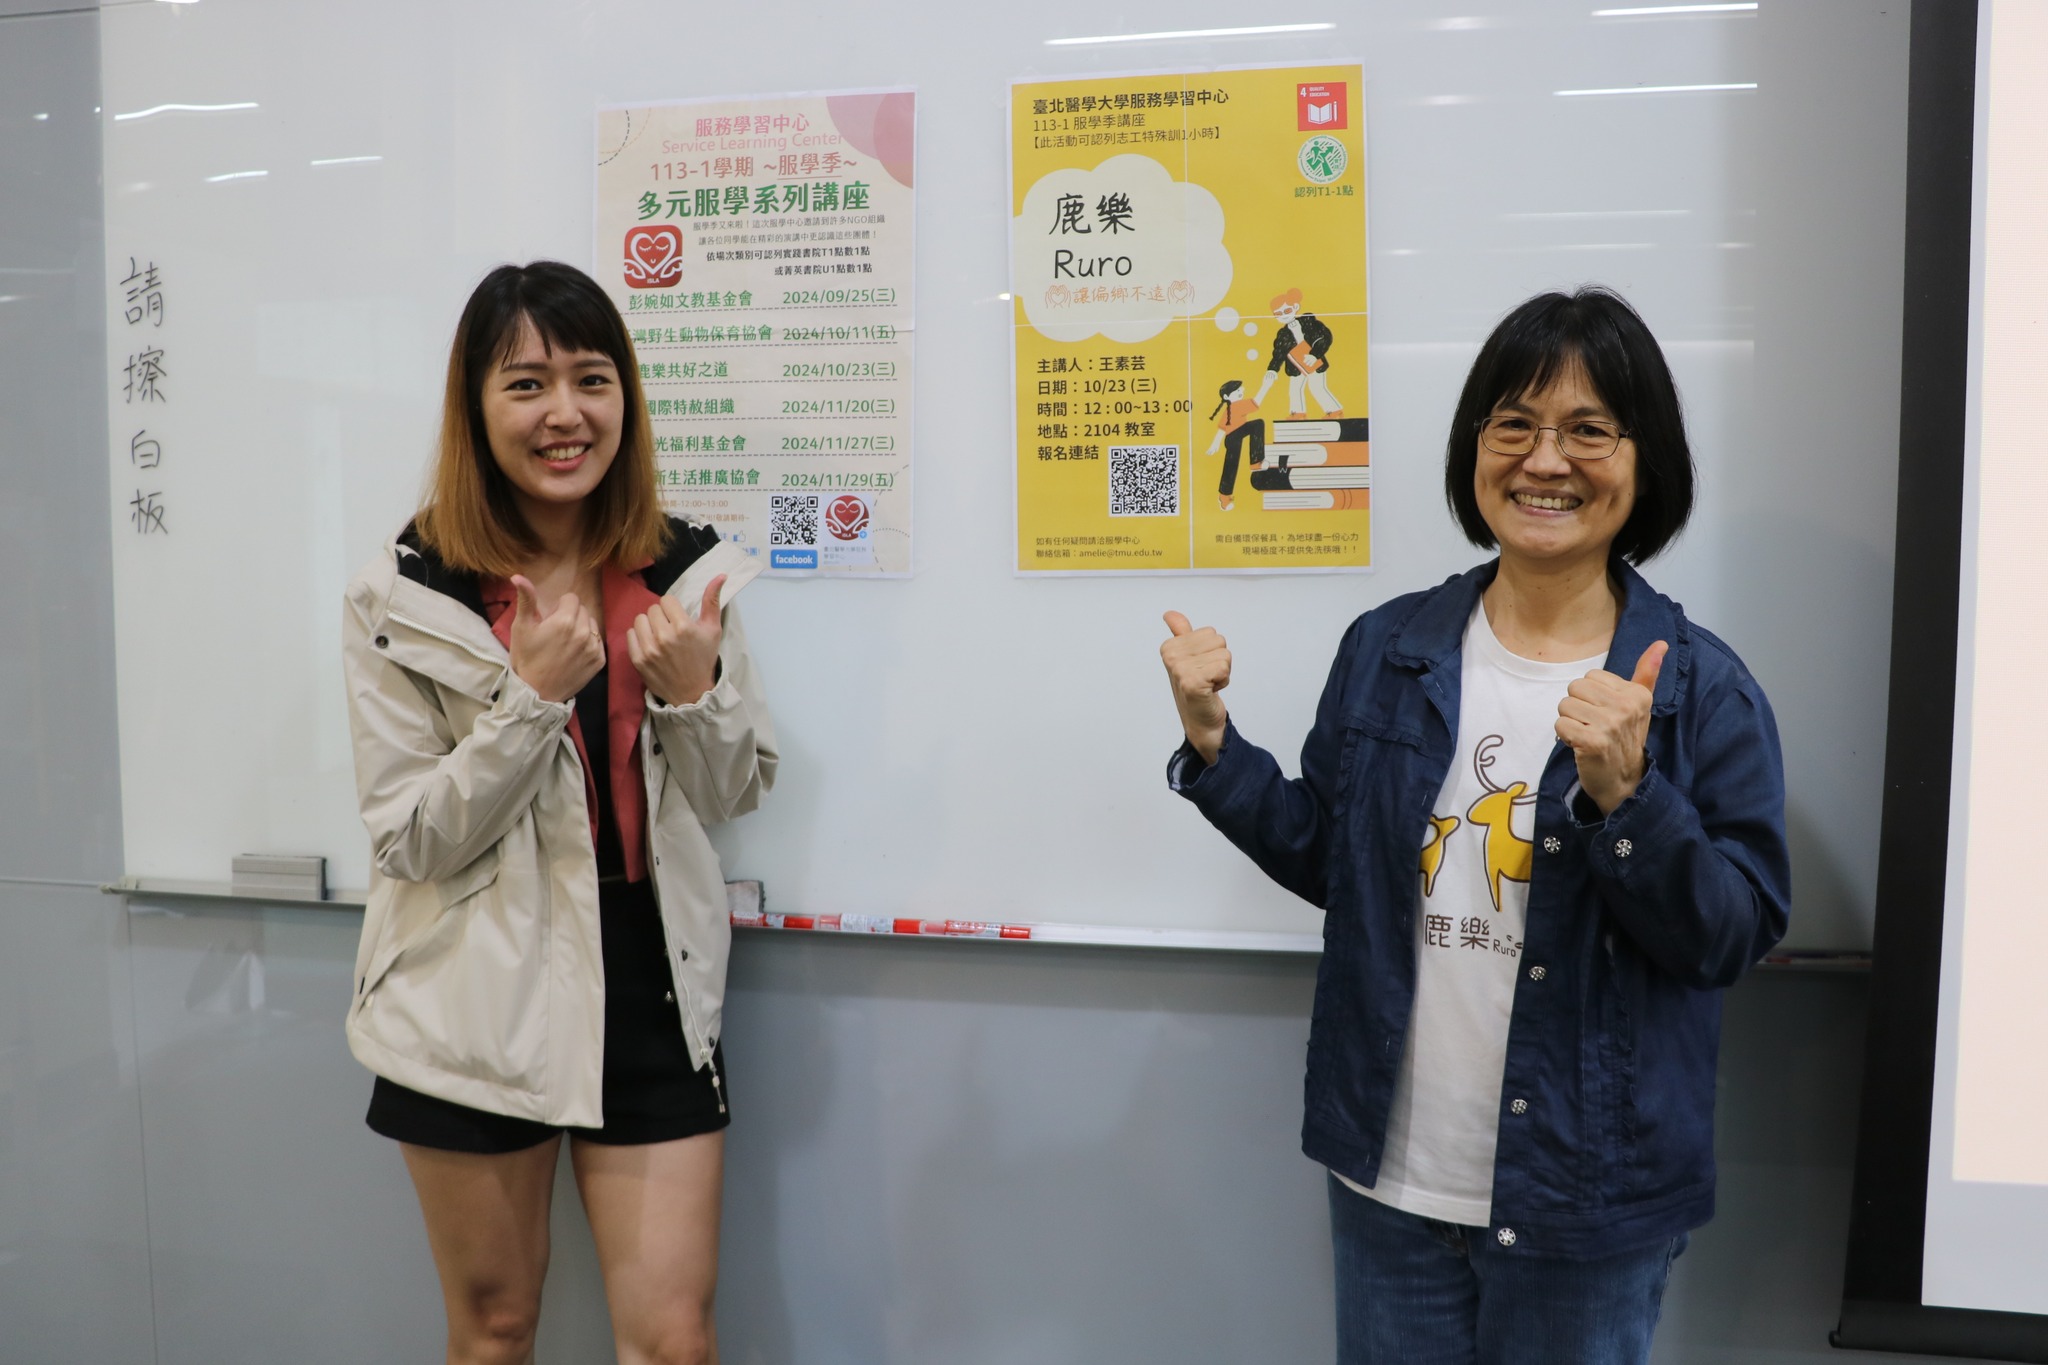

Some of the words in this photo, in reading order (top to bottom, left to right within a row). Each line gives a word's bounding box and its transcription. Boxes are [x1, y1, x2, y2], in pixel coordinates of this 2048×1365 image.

[1033, 88, 1229, 115] 臺北醫學大學服務學習中心
[1300, 87, 1307, 97] 4
[695, 113, 810, 137] 服務學習中心
[1033, 118, 1069, 132] 113-1
[1073, 113, 1146, 129] 服學季講座
[662, 138, 717, 155] Service
[720, 134, 787, 152] Learning
[792, 131, 843, 147] Center
[651, 156, 754, 181] 113-1學期
[637, 181, 870, 220] 多元服學系列講座
[1295, 185, 1354, 198] 認列T1-1點
[1049, 192, 1136, 235] 鹿樂
[1054, 250, 1132, 279] Ruro
[629, 290, 753, 310] 彭婉如文教基金會
[783, 288, 896, 304] 2024/09/25(三)
[1073, 285, 1167, 304] 讓偏鄉不遠
[630, 324, 773, 344] 灣野生動物保育協會
[783, 325, 896, 340] 2024/10/11(五)
[783, 362, 896, 377] 2024/10/23(三)
[1037, 356, 1146, 373] 主講人：王素芸
[120, 256, 168, 535] 請擦白板
[782, 398, 895, 414] 2024/11/20(三)
[1037, 424, 1120, 439] 地點：2104
[1125, 421, 1156, 437] 教室
[781, 436, 895, 451] 2024/11/27(三)
[1037, 445, 1100, 461] 報名連結
[781, 472, 894, 488] 2024/11/29(五)
[775, 554, 813, 564] facebook
[1425, 914, 1490, 950] 鹿樂
[1493, 938, 1517, 958] Ruro
